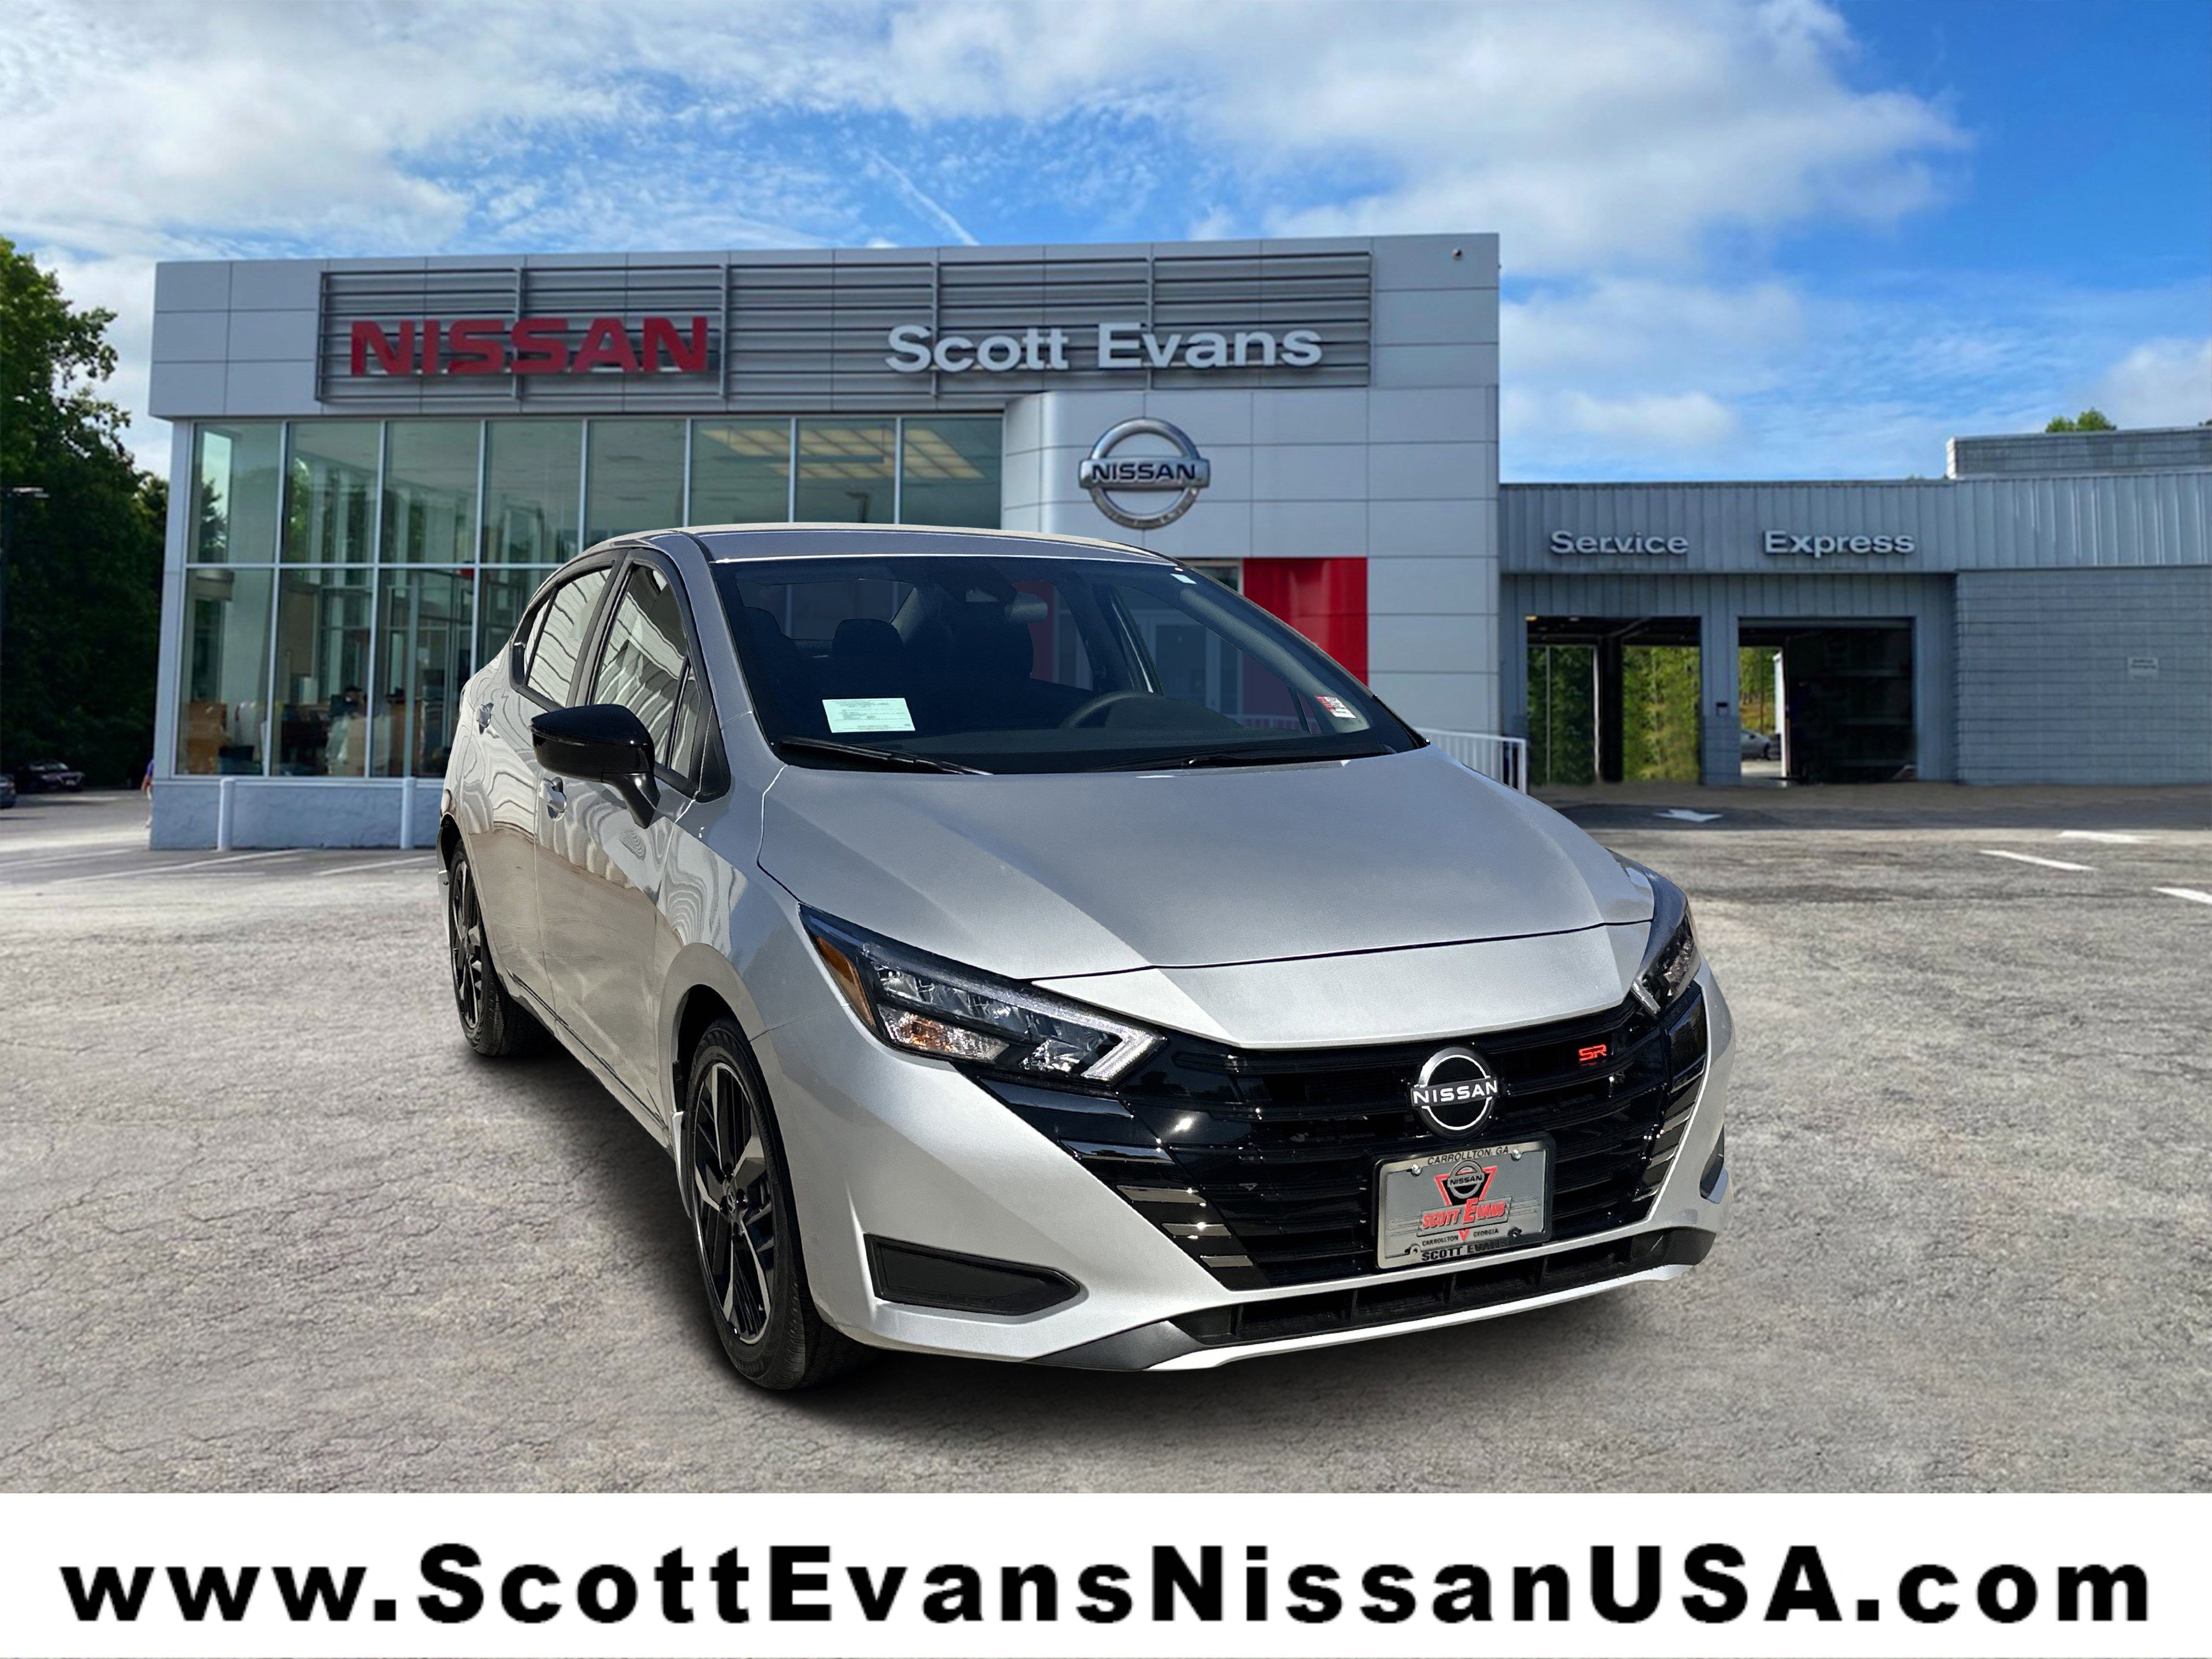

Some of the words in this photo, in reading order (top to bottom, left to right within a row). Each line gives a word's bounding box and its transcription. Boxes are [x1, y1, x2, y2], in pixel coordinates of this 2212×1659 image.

[351, 316, 708, 376] NISSAN
[885, 324, 1069, 372] Scott
[1098, 321, 1323, 369] Evans
[1092, 464, 1195, 480] NISSAN
[1550, 530, 1689, 555] Service
[1764, 529, 1915, 558] Express
[1578, 1044, 1607, 1061] SR
[1413, 1080, 1498, 1104] NISSAN
[1496, 1146, 1509, 1155] GA
[1450, 1175, 1482, 1186] NISSAN
[1422, 1209, 1461, 1229] SCOTT
[1422, 1235, 1459, 1246] CARROLLTON
[1473, 1228, 1499, 1238] GEORGIA
[1421, 1246, 1463, 1261] SCOTT
